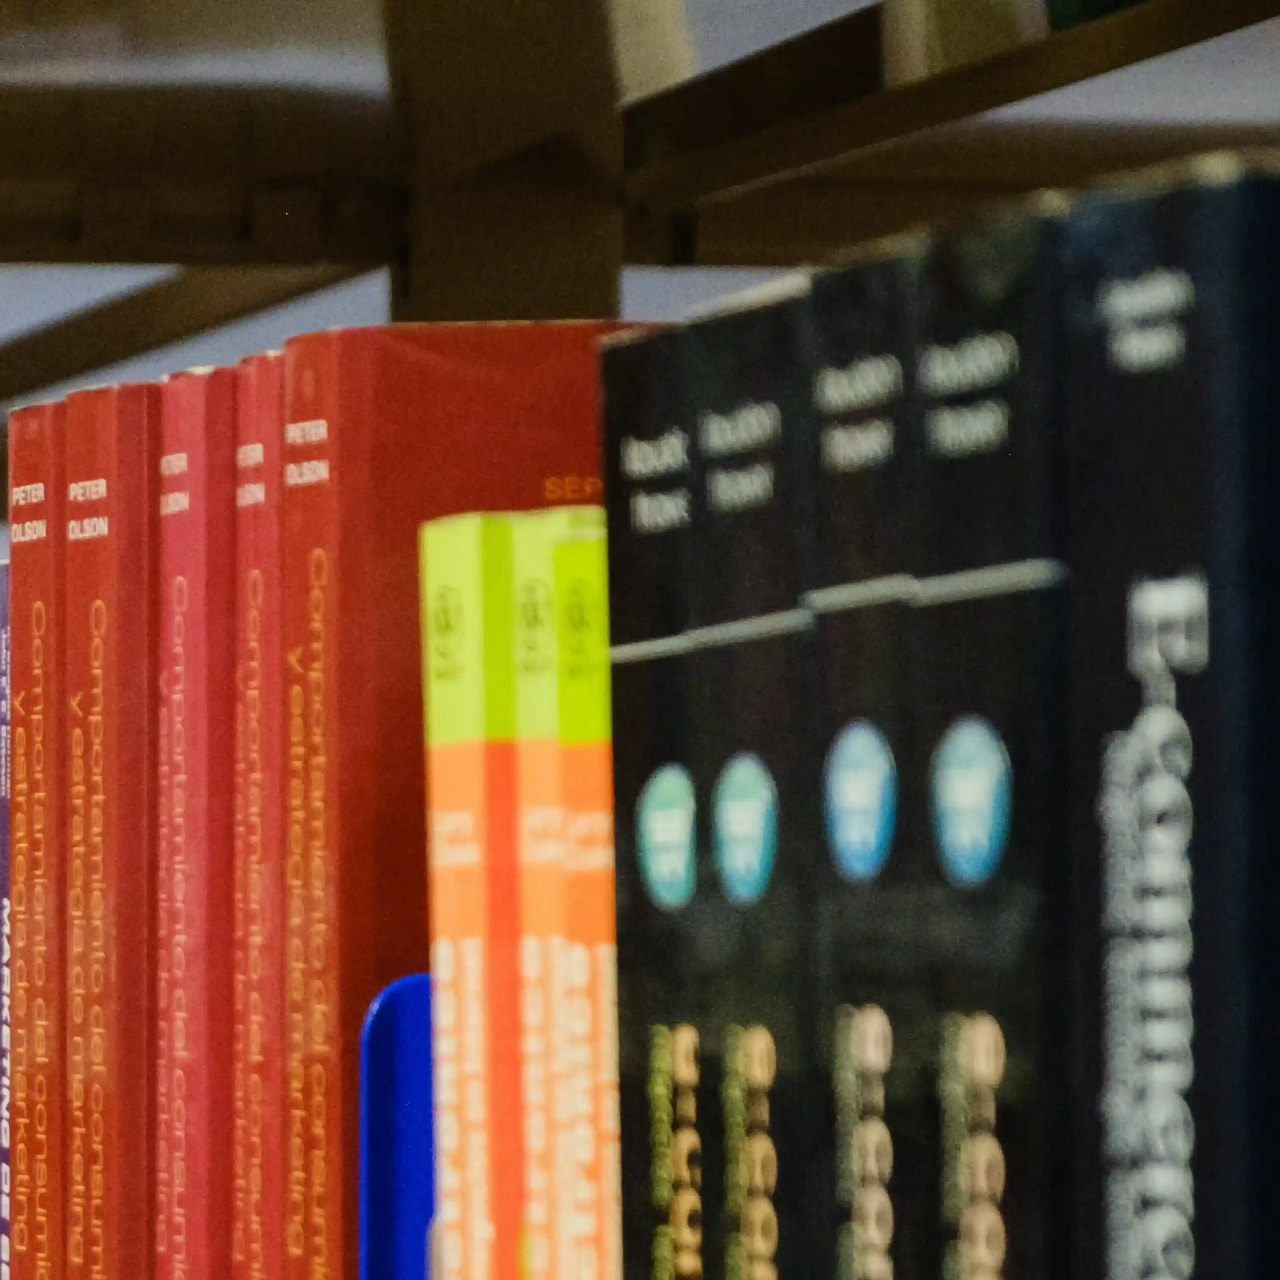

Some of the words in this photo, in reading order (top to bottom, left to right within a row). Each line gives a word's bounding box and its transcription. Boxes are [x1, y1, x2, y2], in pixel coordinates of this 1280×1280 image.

[284, 419, 328, 444] PETER
[12, 482, 44, 506] PETER
[68, 478, 107, 502] PETER
[284, 459, 330, 486] OLSON
[11, 519, 47, 543] OLSON
[68, 516, 108, 541] OLSON
[30, 599, 47, 986] Comportamiento
[171, 575, 189, 978] Comportamiento
[246, 568, 264, 981] Comportamiento
[309, 547, 328, 970] Comportamiento
[89, 599, 107, 994] Comportamiento
[287, 684, 307, 927] estrategia
[13, 726, 30, 947] estrategia
[69, 727, 87, 949] estrategia
[14, 962, 28, 1002] de
[72, 966, 86, 1024] de
[290, 936, 307, 999] de
[0, 897, 11, 1149] MARKETING
[33, 998, 49, 1064] del
[91, 1006, 108, 1073] del
[173, 988, 190, 1060] del
[249, 991, 265, 1062] del
[312, 979, 331, 1055] del
[13, 1028, 30, 1251] marketing
[70, 1036, 88, 1265] marketing
[287, 1011, 307, 1256] marketing
[0, 1162, 10, 1220] DE
